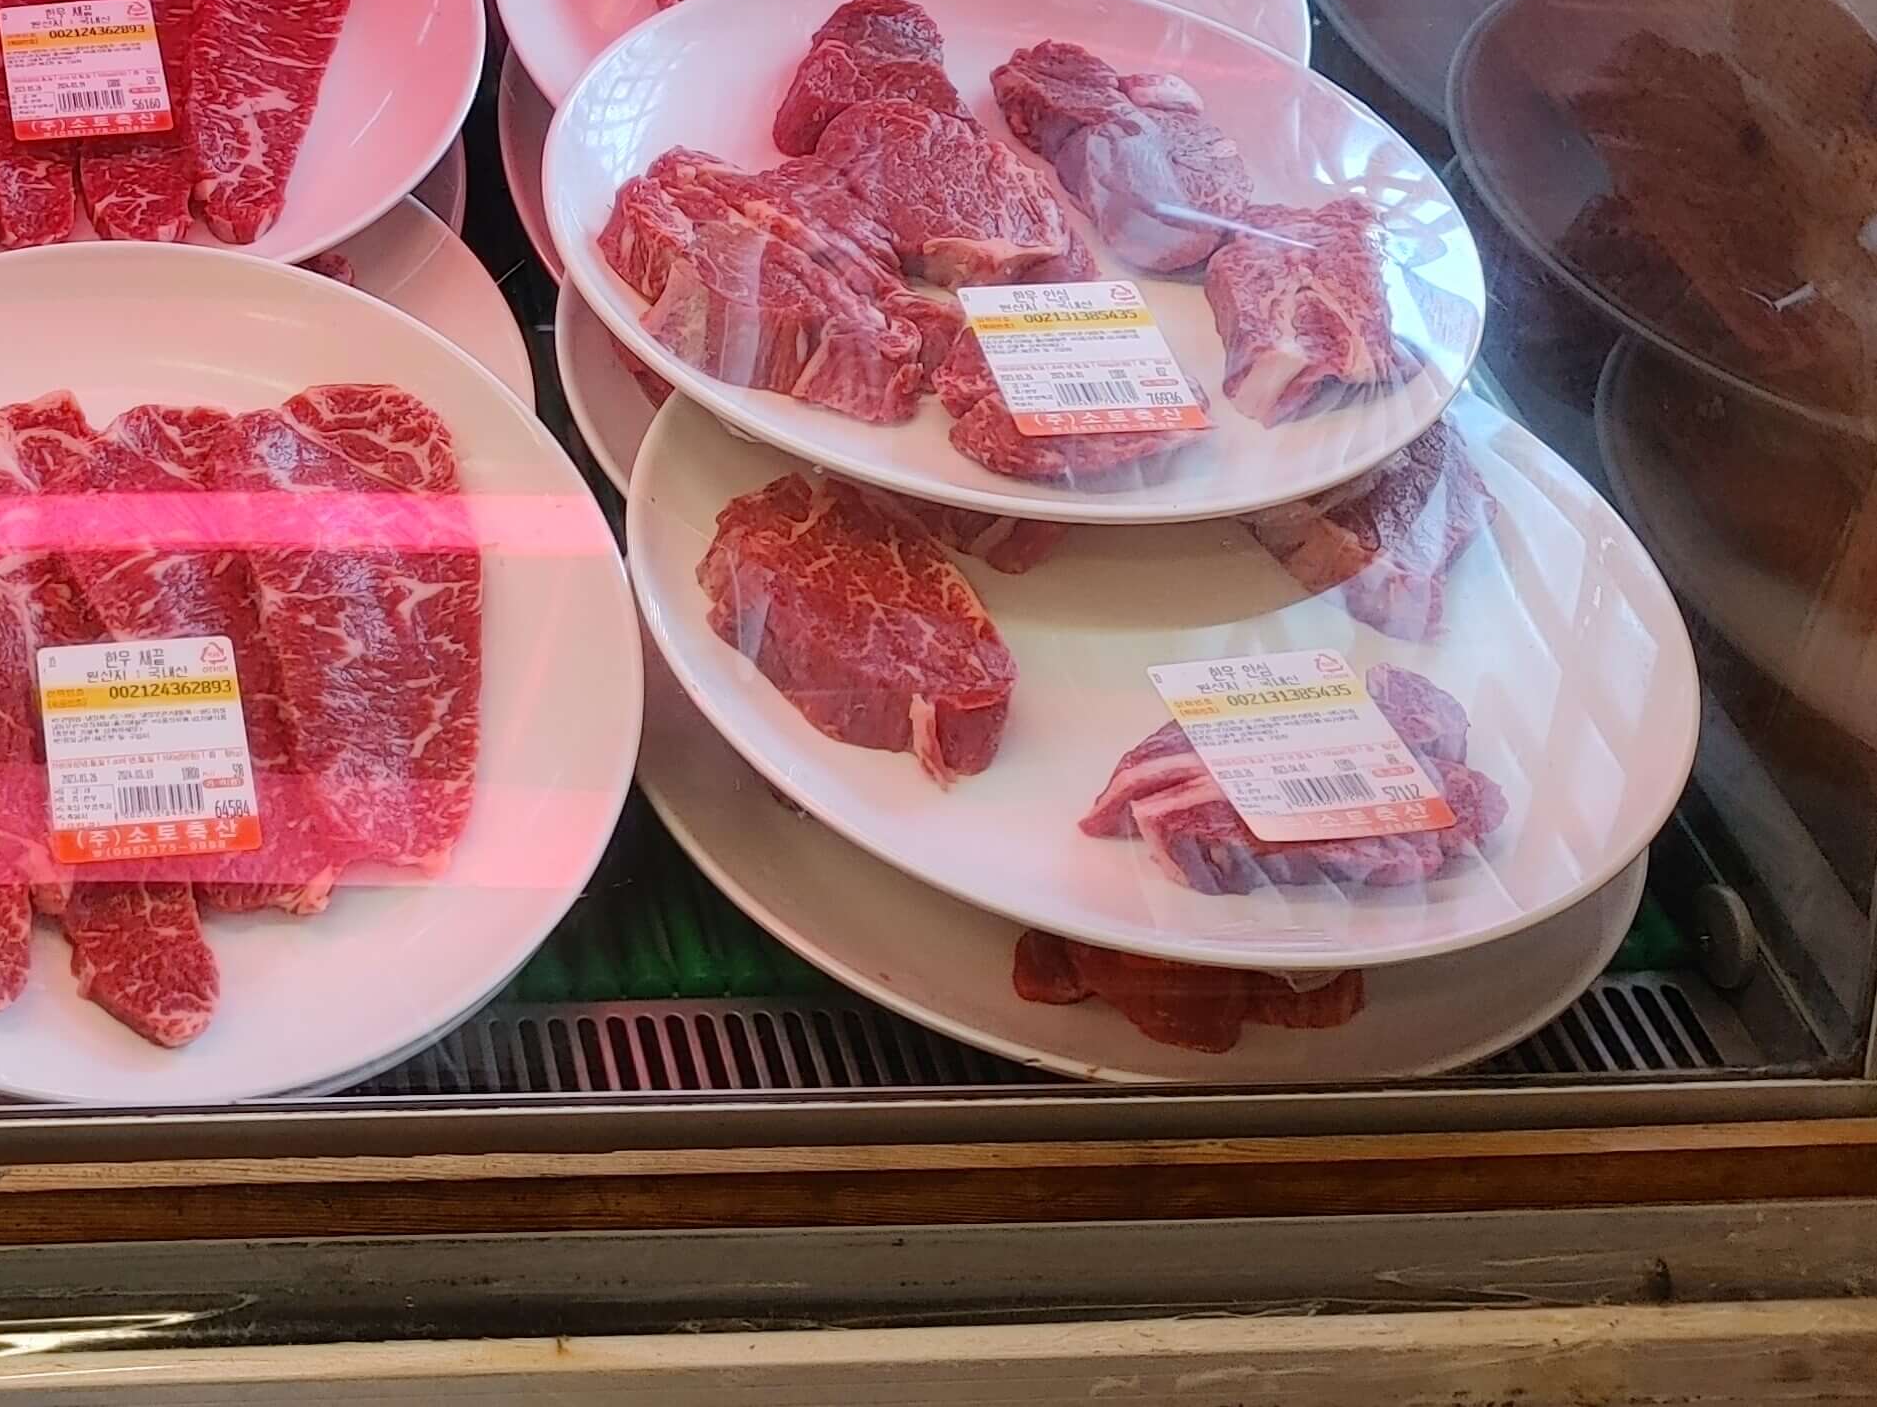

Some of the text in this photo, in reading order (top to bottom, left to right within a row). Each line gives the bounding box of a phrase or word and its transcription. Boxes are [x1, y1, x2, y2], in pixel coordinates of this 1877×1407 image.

[109, 679, 232, 699] 002124362893
[1226, 683, 1351, 707] 002131385435
[1381, 784, 1421, 801] 57112
[214, 799, 251, 819] 64584
